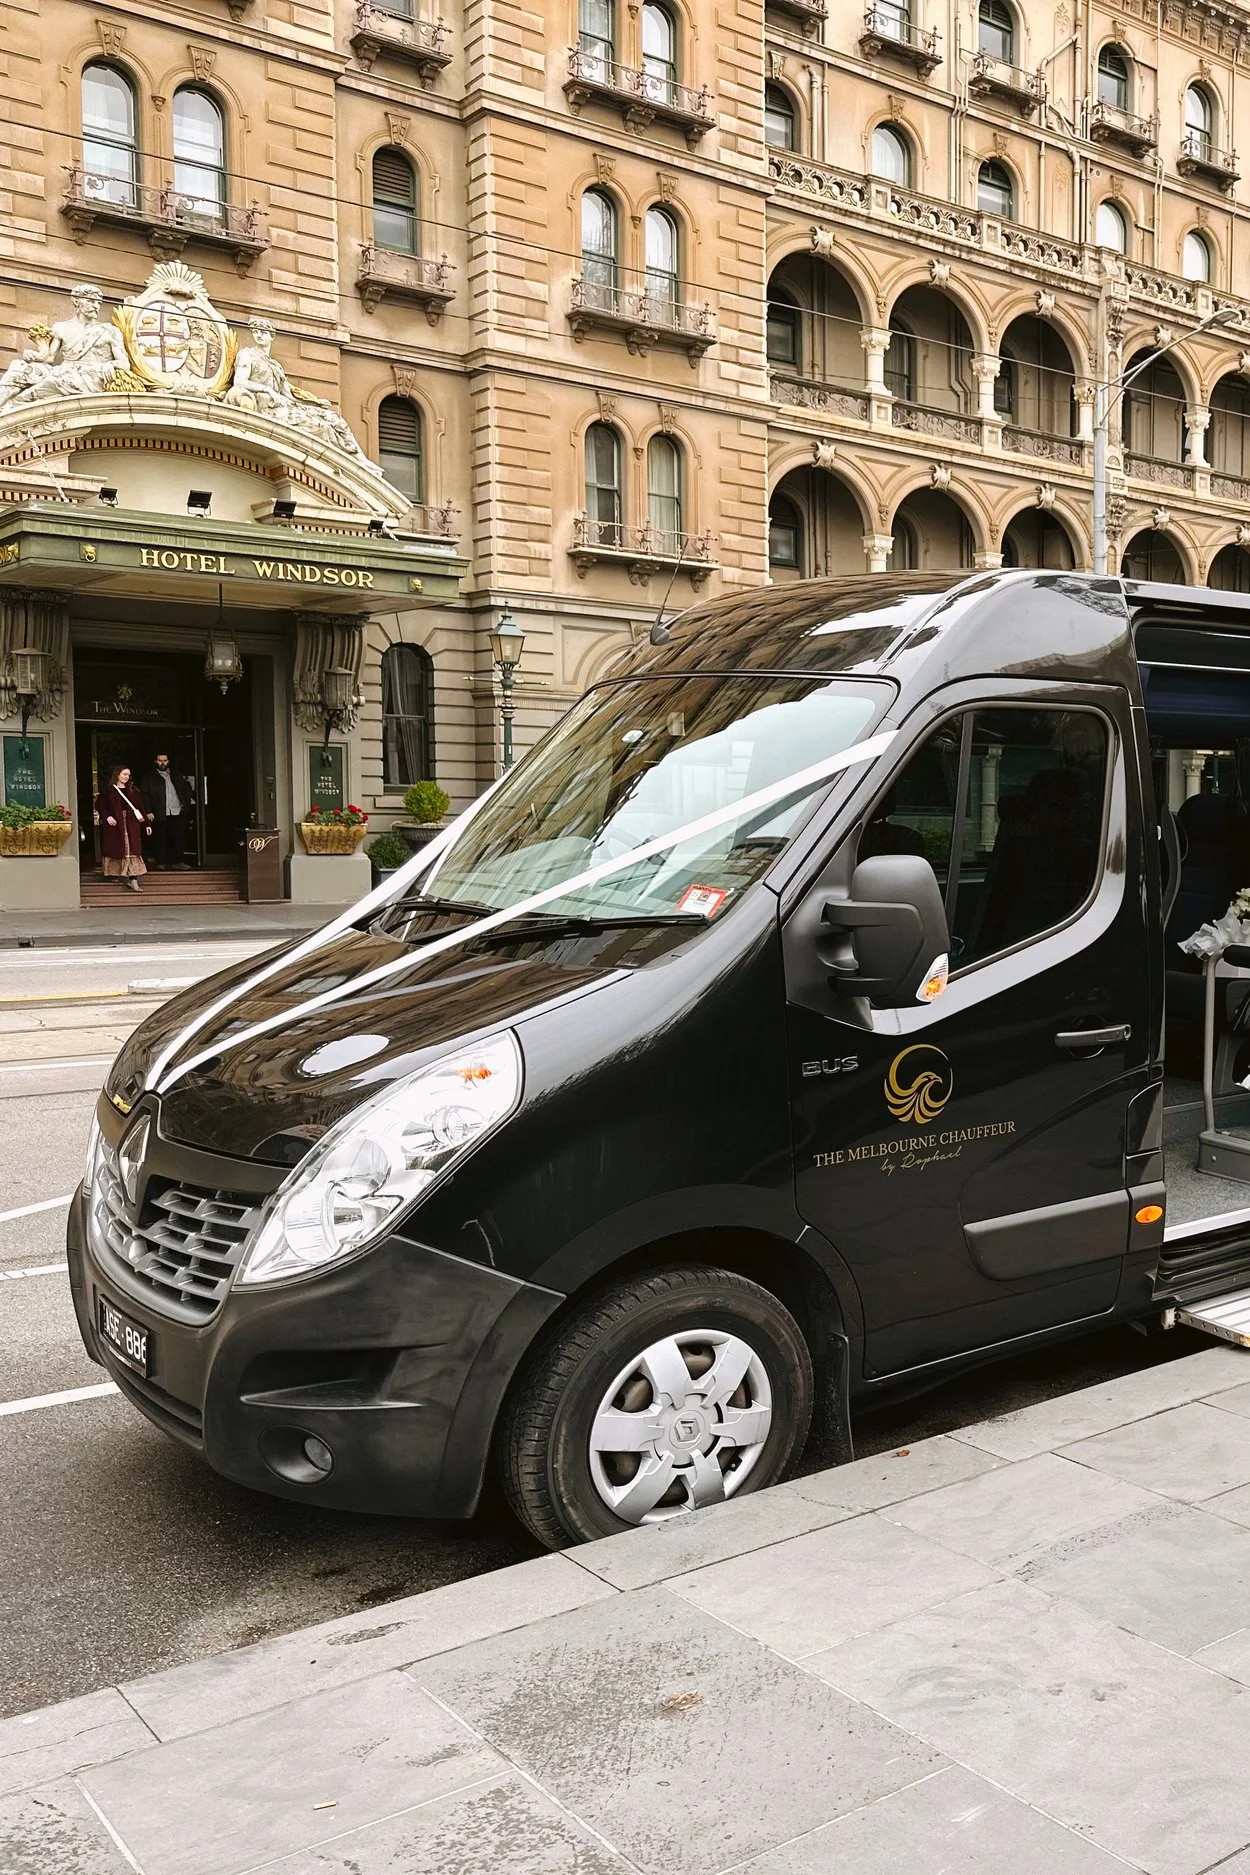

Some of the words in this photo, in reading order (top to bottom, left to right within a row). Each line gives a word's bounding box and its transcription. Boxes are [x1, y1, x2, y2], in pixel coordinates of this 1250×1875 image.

[140, 548, 235, 575] HOTEL
[252, 560, 374, 589] WINDSOR
[802, 1055, 859, 1078] BUS
[813, 1150, 845, 1168] THE
[847, 1134, 937, 1162] MELBOURNE
[939, 1120, 1016, 1147] CHAUFFEUR
[880, 1159, 895, 1176] by
[900, 1145, 962, 1171] Raphael
